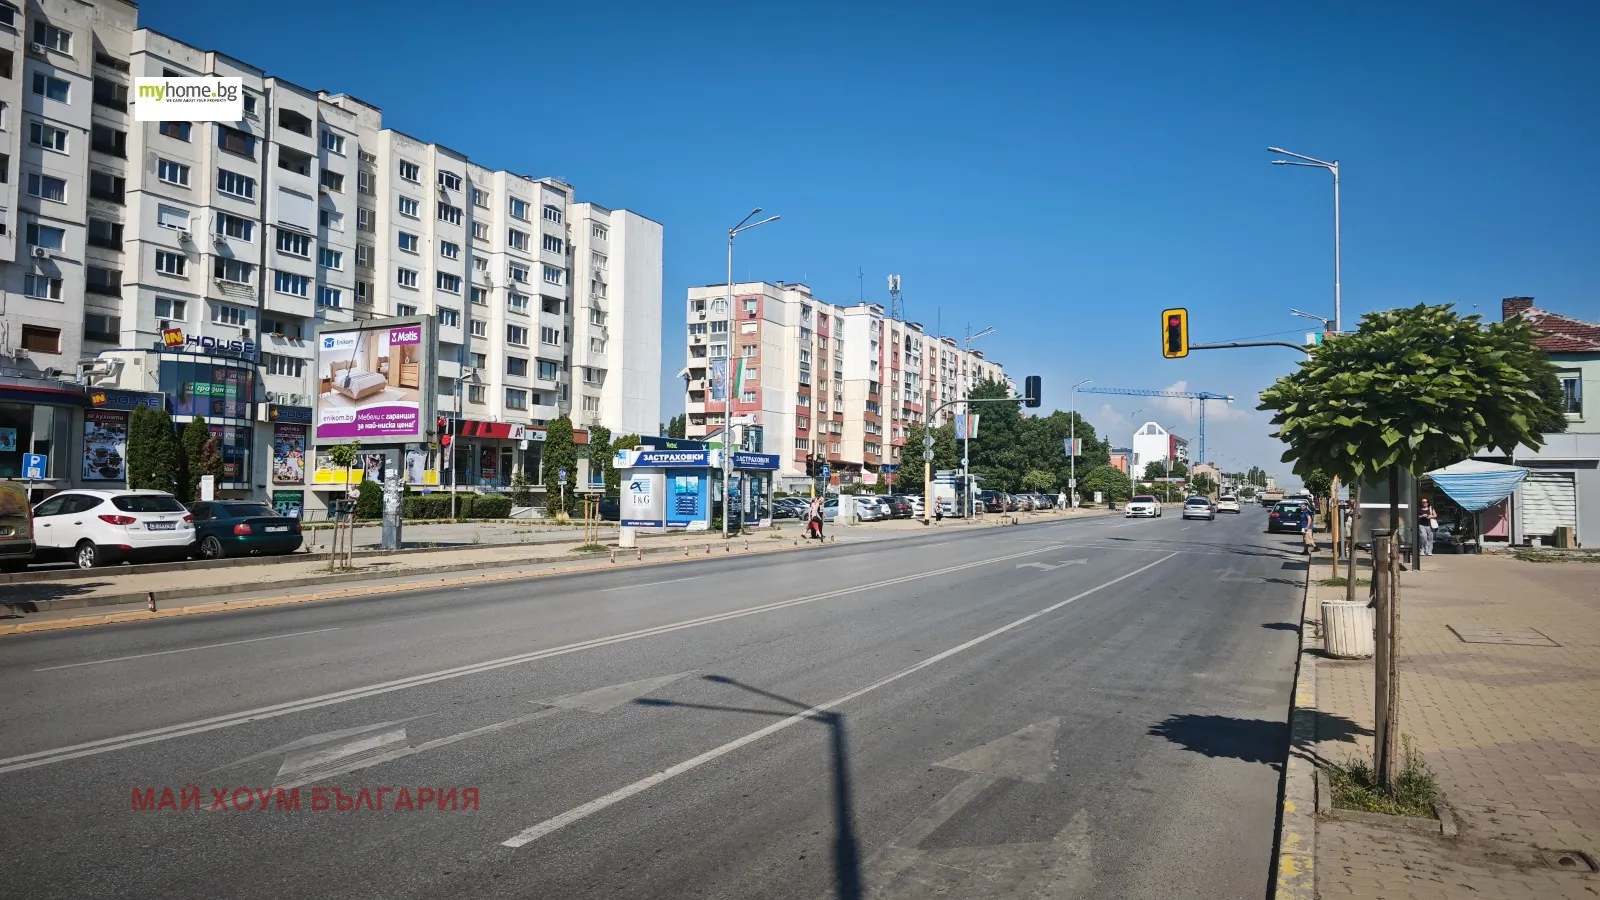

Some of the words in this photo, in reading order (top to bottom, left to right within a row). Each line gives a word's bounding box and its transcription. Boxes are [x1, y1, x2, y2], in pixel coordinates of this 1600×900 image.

[397, 331, 418, 342] Matis
[164, 331, 183, 344] IN
[185, 333, 255, 353] HOUSE
[91, 393, 106, 404] IN
[107, 395, 159, 407] HOUSE
[323, 414, 354, 422] enikom.bg
[357, 413, 381, 421] Мебели
[386, 413, 415, 421] гаранция
[364, 421, 396, 429] най-ниска
[30, 455, 41, 467] P
[643, 453, 704, 461] ЗАСТРАХОВКИ
[736, 455, 770, 463] ЗАСТРАХОВКИ
